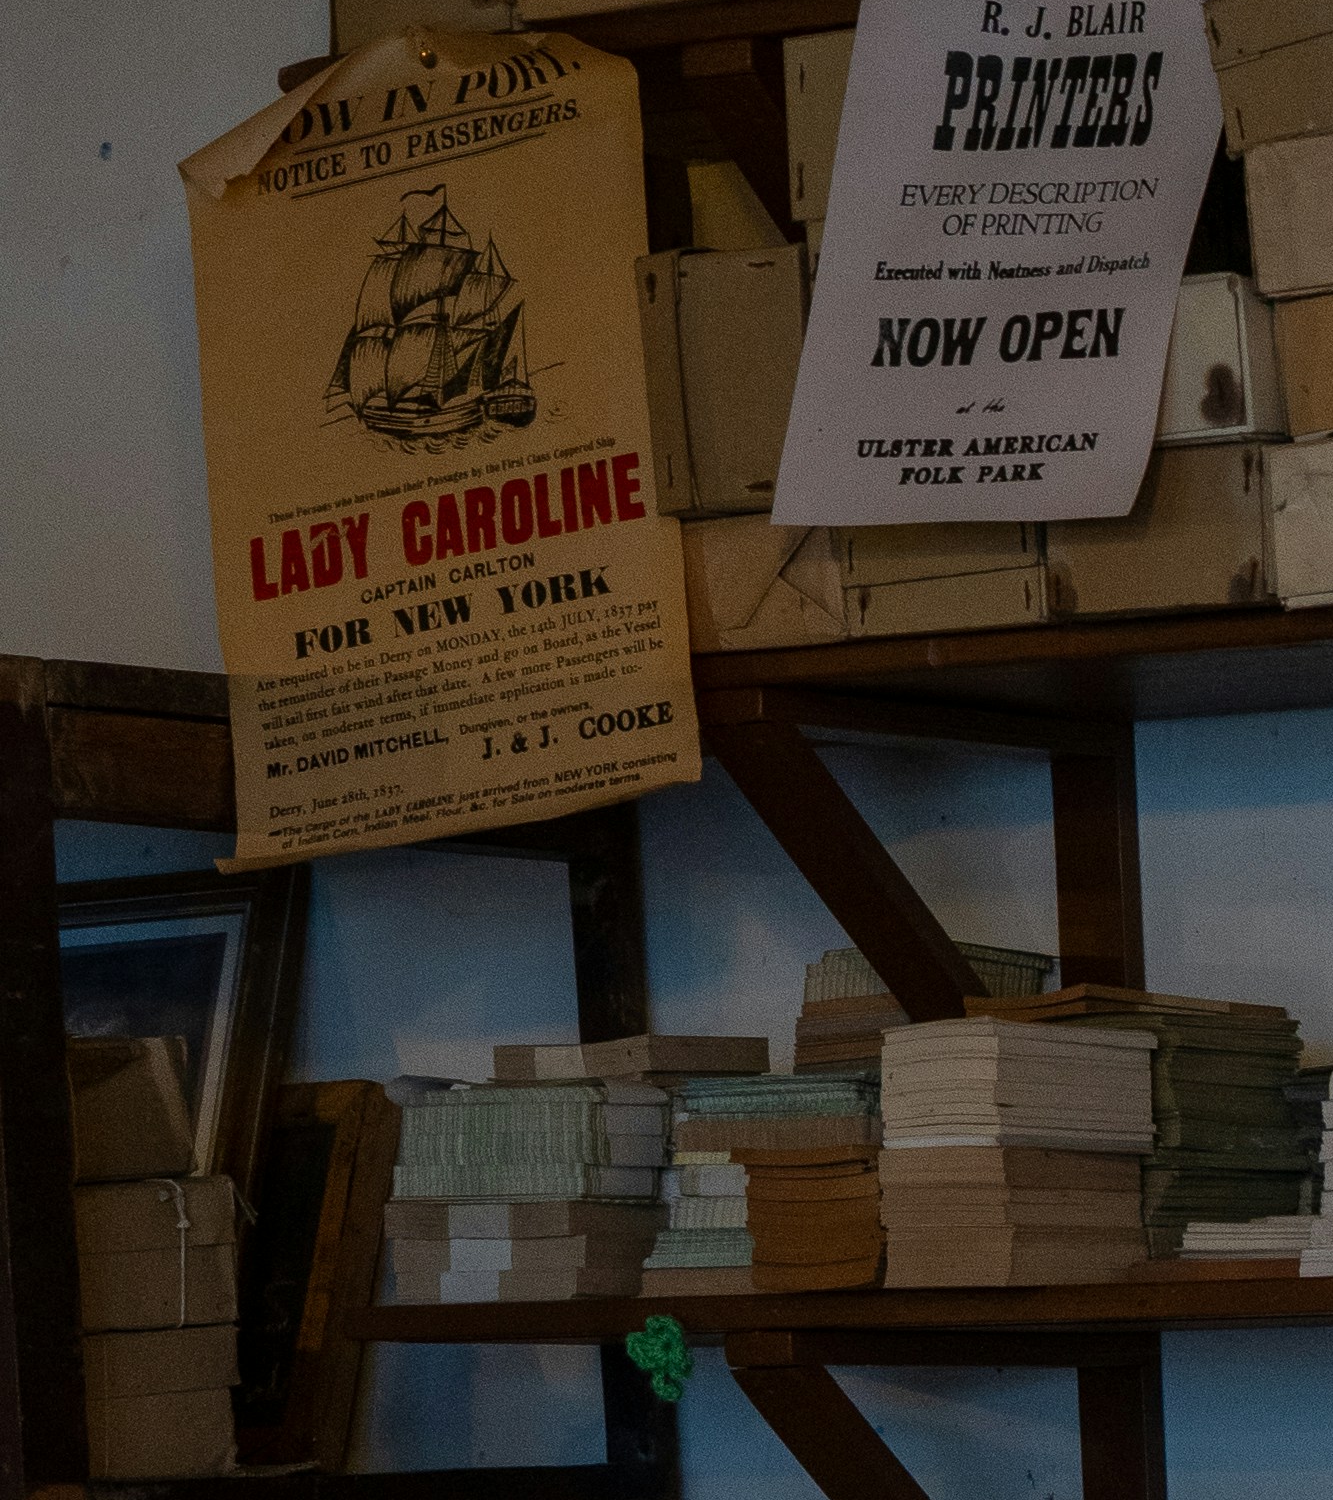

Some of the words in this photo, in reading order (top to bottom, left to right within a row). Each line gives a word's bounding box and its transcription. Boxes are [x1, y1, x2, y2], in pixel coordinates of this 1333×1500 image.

[979, 0, 1010, 37] R.
[1024, 5, 1052, 41] J.
[1065, 0, 1146, 38] BLAIR
[282, 95, 363, 149] OW
[380, 79, 435, 122] IN
[452, 50, 581, 105] PORT.
[931, 50, 1164, 152] PRINTERS
[253, 151, 347, 195] NOTICE
[359, 140, 392, 170] TO
[405, 97, 581, 159] PASSENGERS.
[898, 182, 986, 207] EVERY
[986, 176, 1159, 205] DESCRIPTION
[941, 212, 978, 236] OF
[980, 210, 1103, 236] PRINTING
[873, 259, 944, 281] Executed
[946, 259, 982, 281] with
[986, 259, 1052, 280] Neatness
[1055, 255, 1085, 276] and
[1085, 251, 1150, 275] Dispatch
[869, 315, 988, 368] NOW
[997, 306, 1125, 363] OPEN
[856, 437, 954, 458] ULSTER
[961, 431, 1099, 457] AMERICAN
[897, 465, 965, 485] FOLK
[975, 461, 1045, 484] PARK
[248, 511, 370, 602] LADY
[400, 450, 646, 567] CAROLINE
[359, 571, 437, 605] CAPTAIN
[447, 551, 535, 584] CARLTON
[293, 617, 372, 660] FOR
[391, 594, 471, 638] NEW
[495, 565, 611, 615] YORK
[265, 760, 293, 779] Mr.
[295, 746, 350, 773] DAVID
[352, 727, 450, 760] MITCHELL,
[481, 735, 501, 761] J.
[509, 730, 529, 755] &
[538, 723, 558, 749] J.
[577, 699, 674, 740] COOKE
